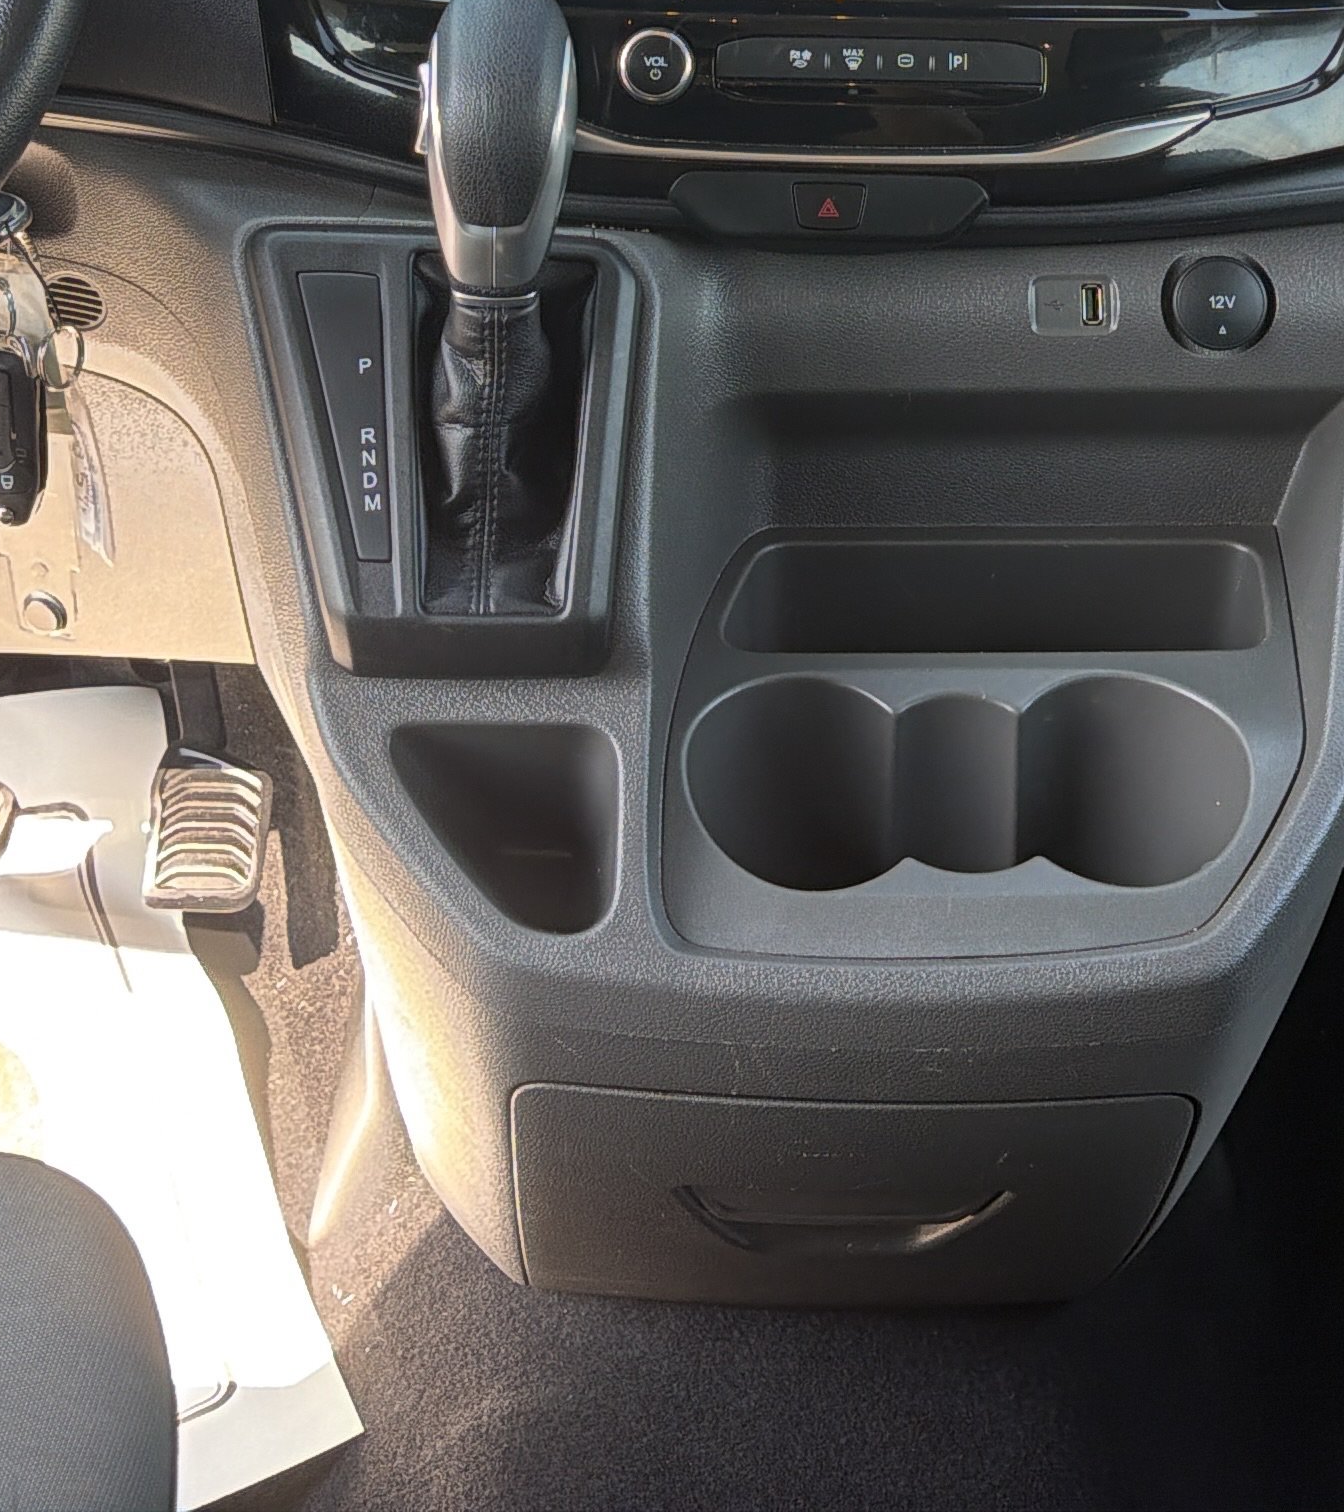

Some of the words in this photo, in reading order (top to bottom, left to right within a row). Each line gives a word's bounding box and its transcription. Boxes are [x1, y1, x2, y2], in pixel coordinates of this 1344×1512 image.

[643, 56, 668, 67] VOL
[842, 48, 865, 57] MAX
[1208, 294, 1237, 309] 12V
[358, 357, 373, 375] P
[360, 427, 377, 445] R
[361, 449, 377, 467] N
[362, 471, 378, 489] D
[364, 493, 382, 512] M
